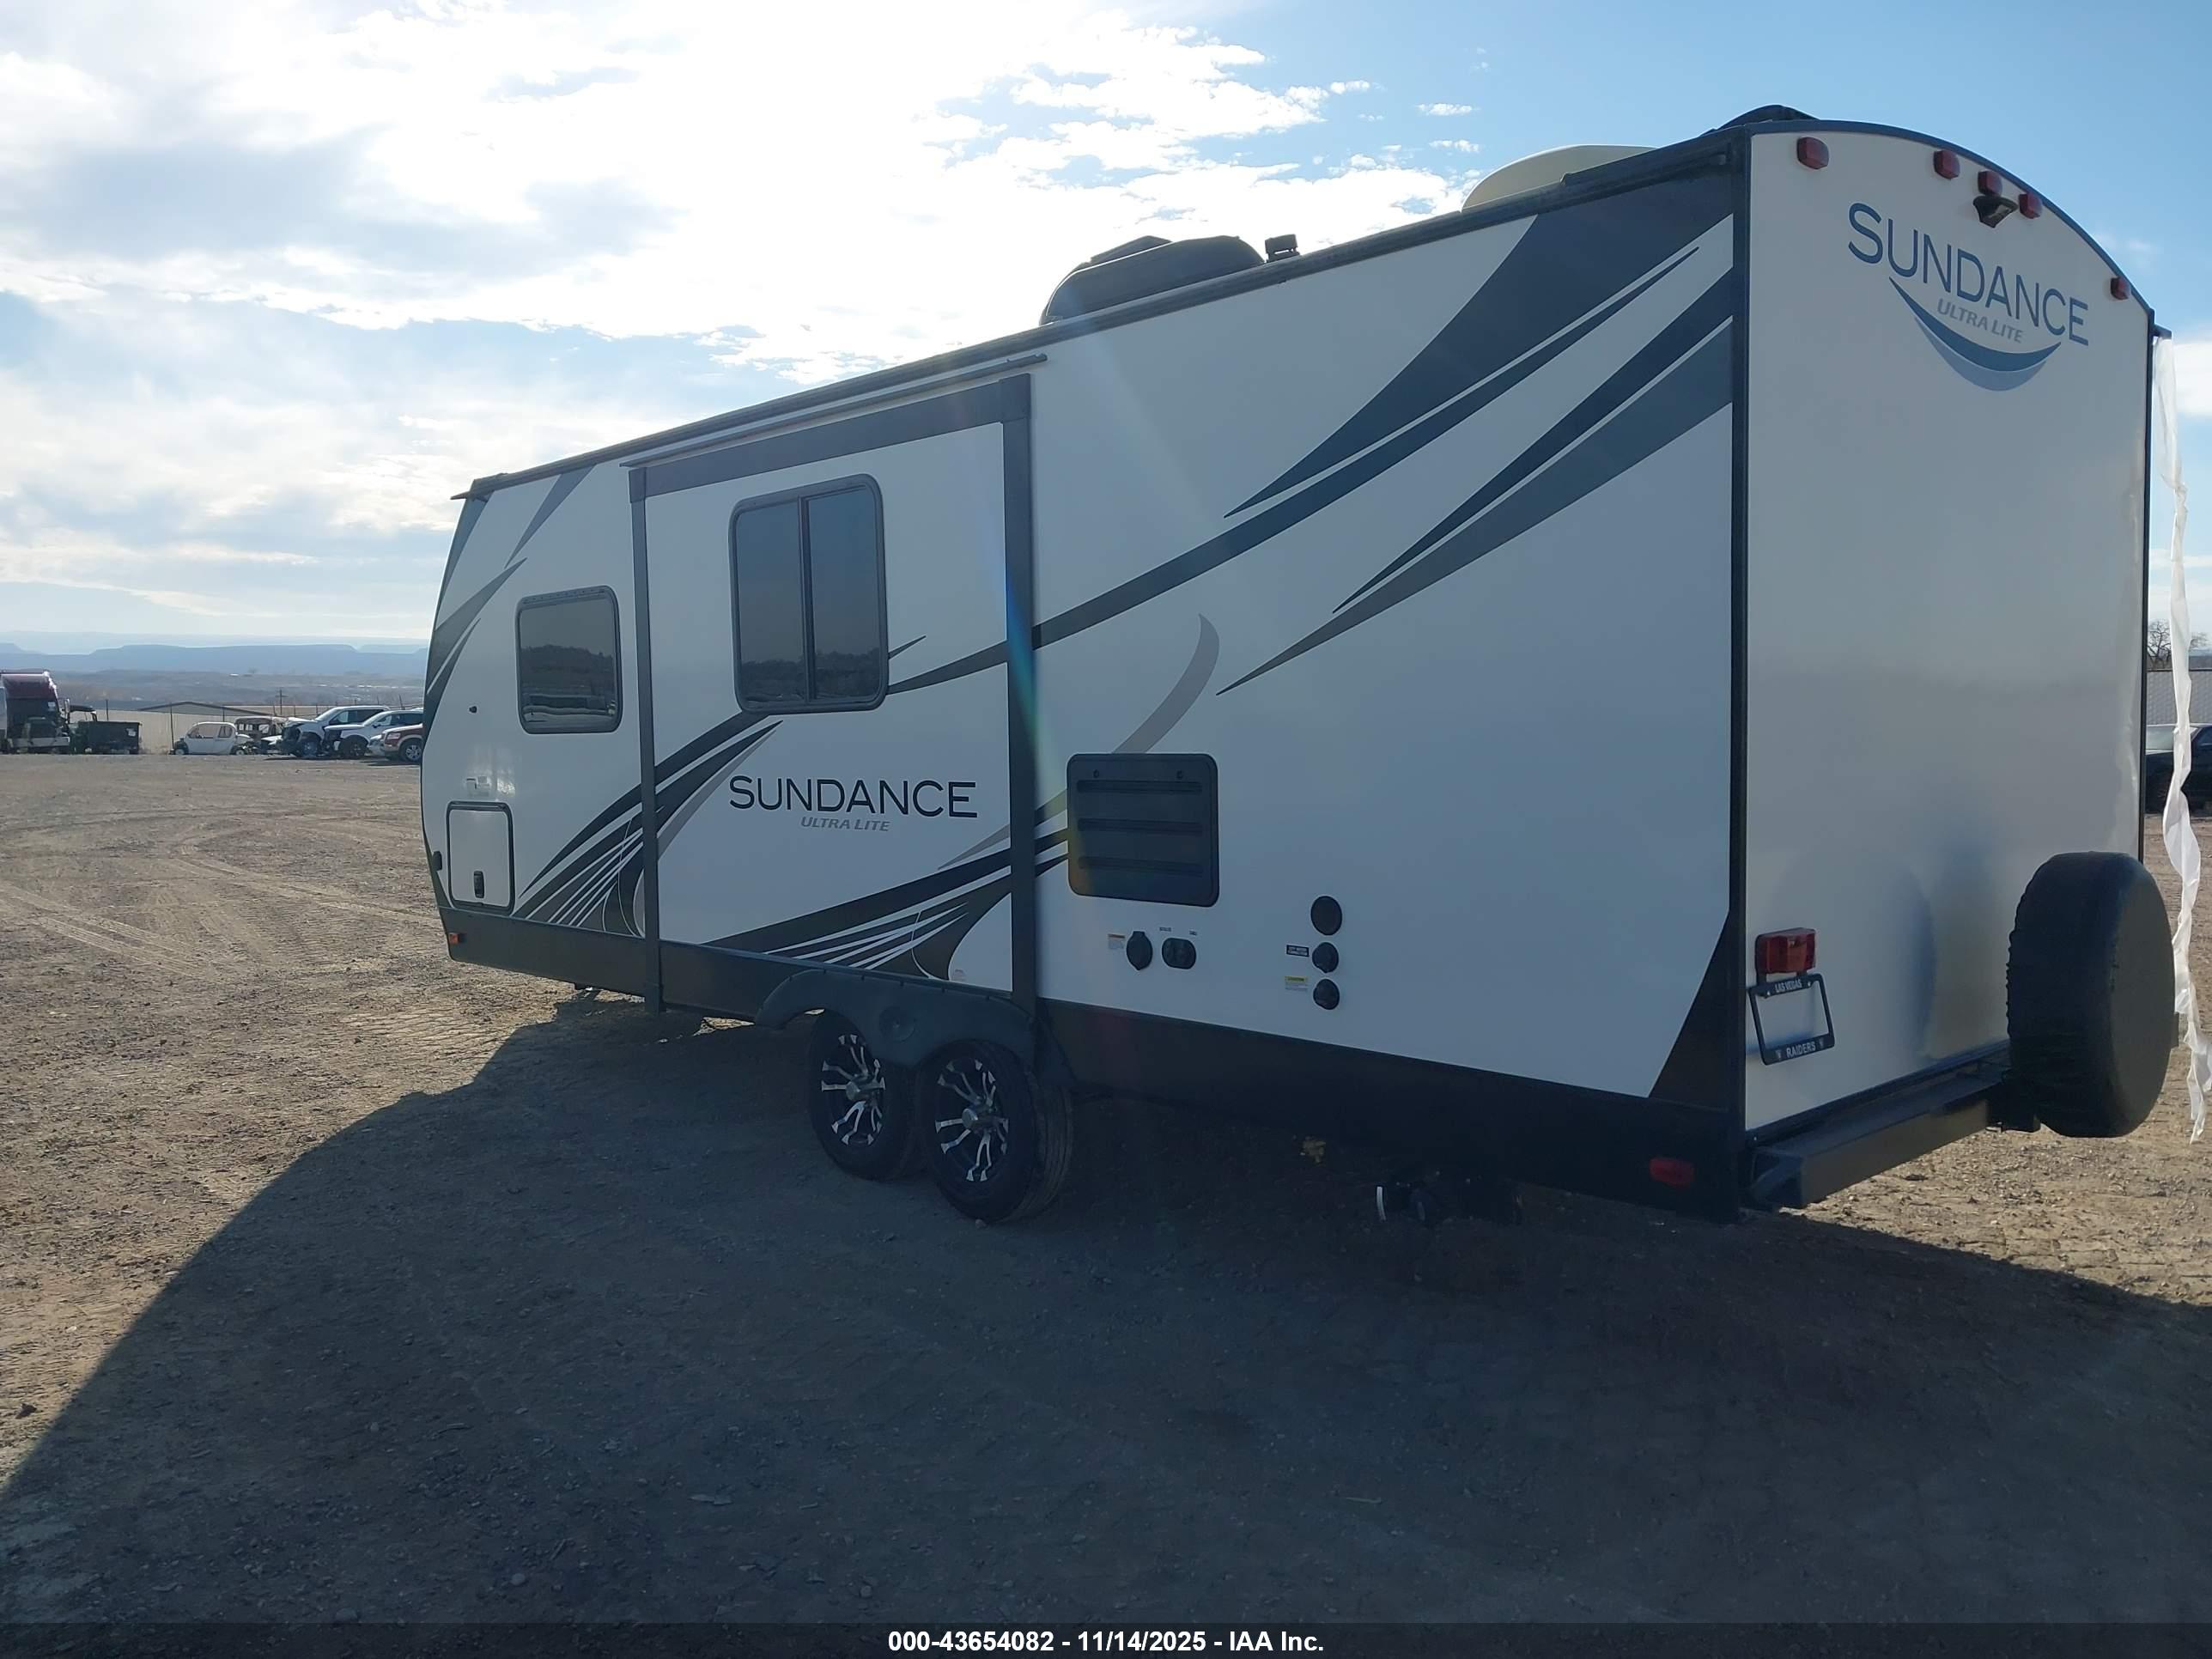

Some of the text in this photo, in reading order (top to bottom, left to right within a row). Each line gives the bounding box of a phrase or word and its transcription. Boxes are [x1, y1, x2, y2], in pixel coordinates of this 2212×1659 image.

[1848, 203, 2089, 346] SUNDANCE
[1937, 298, 2024, 343] ULTRA LITE
[730, 775, 978, 818] SUNDANCE
[800, 817, 890, 832] ULTRA LITE
[1786, 1041, 1816, 1058] RAIDERS
